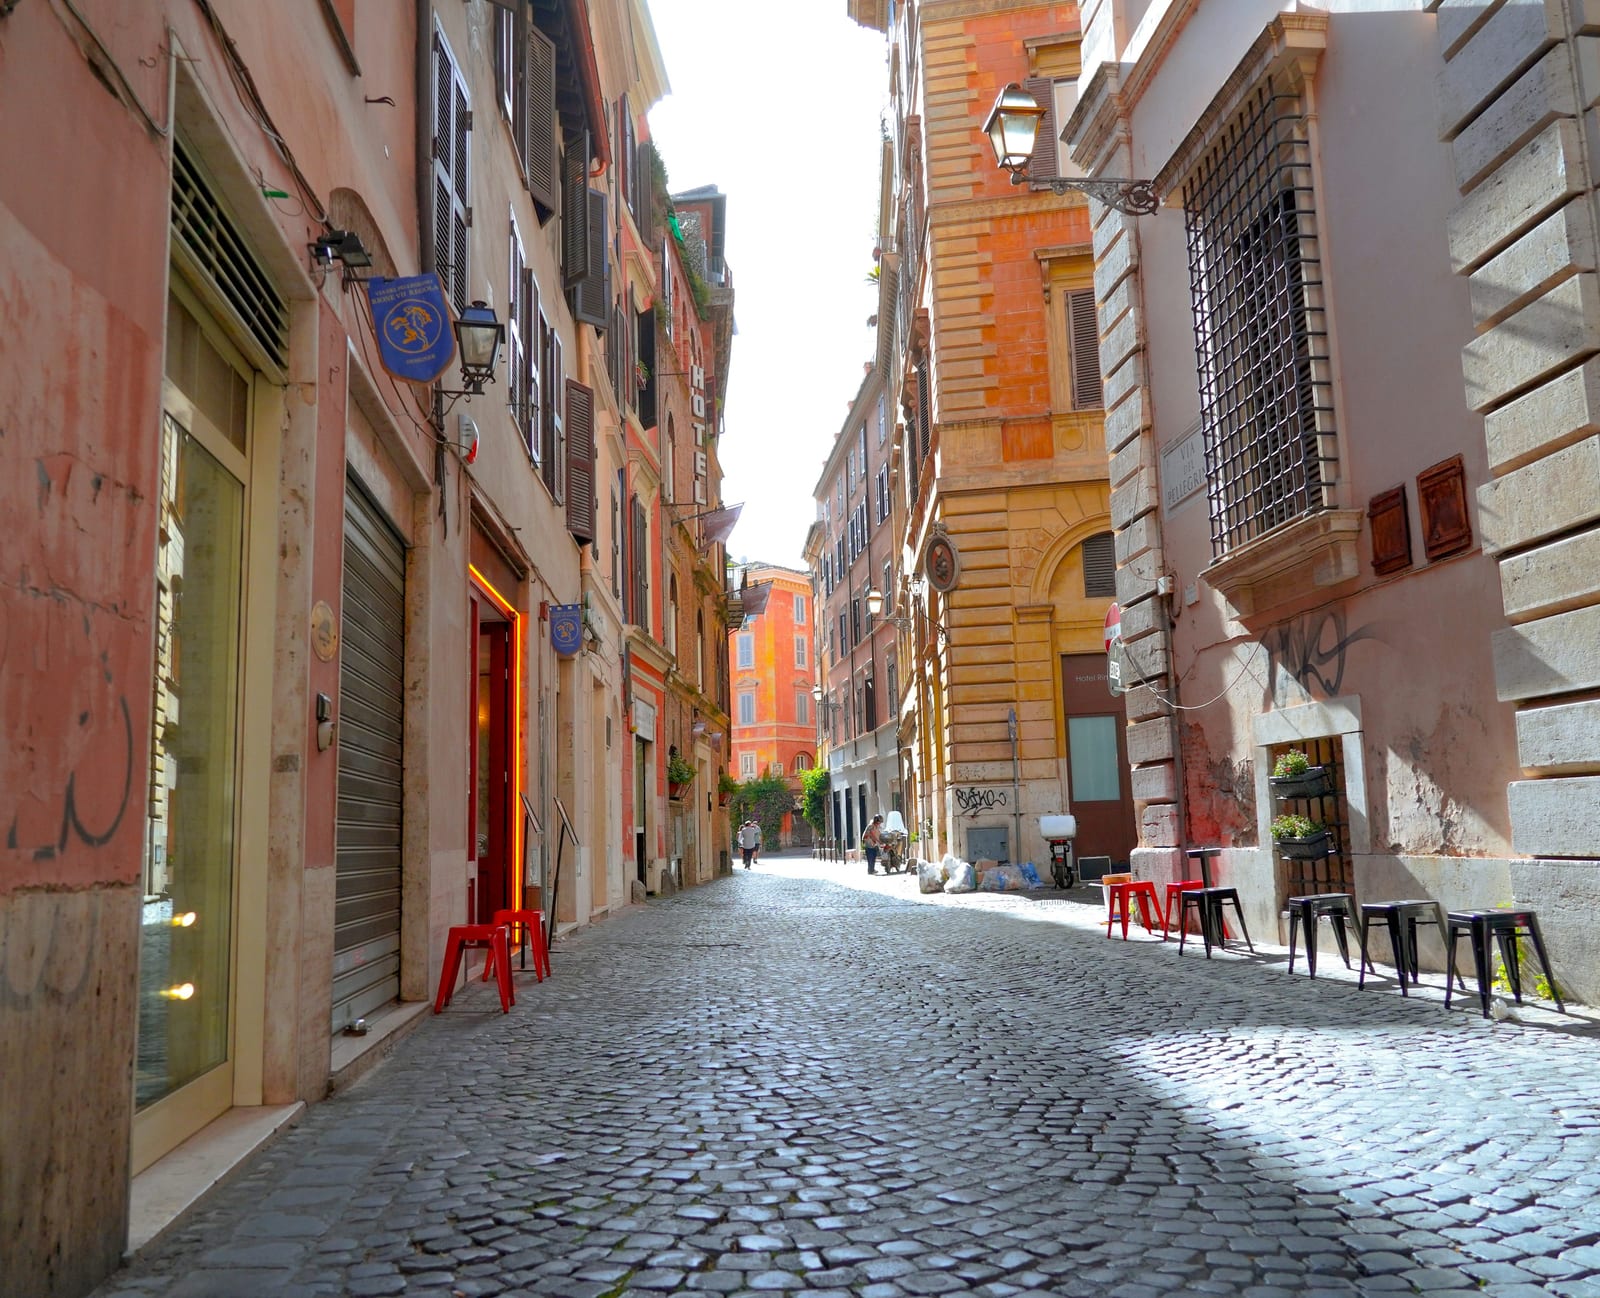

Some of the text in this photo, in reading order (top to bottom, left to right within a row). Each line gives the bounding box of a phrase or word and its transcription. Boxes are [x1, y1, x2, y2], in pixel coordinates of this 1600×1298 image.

[691, 364, 708, 507] HOTEL
[1180, 441, 1195, 459] VIA
[1076, 674, 1096, 682] Hotel
